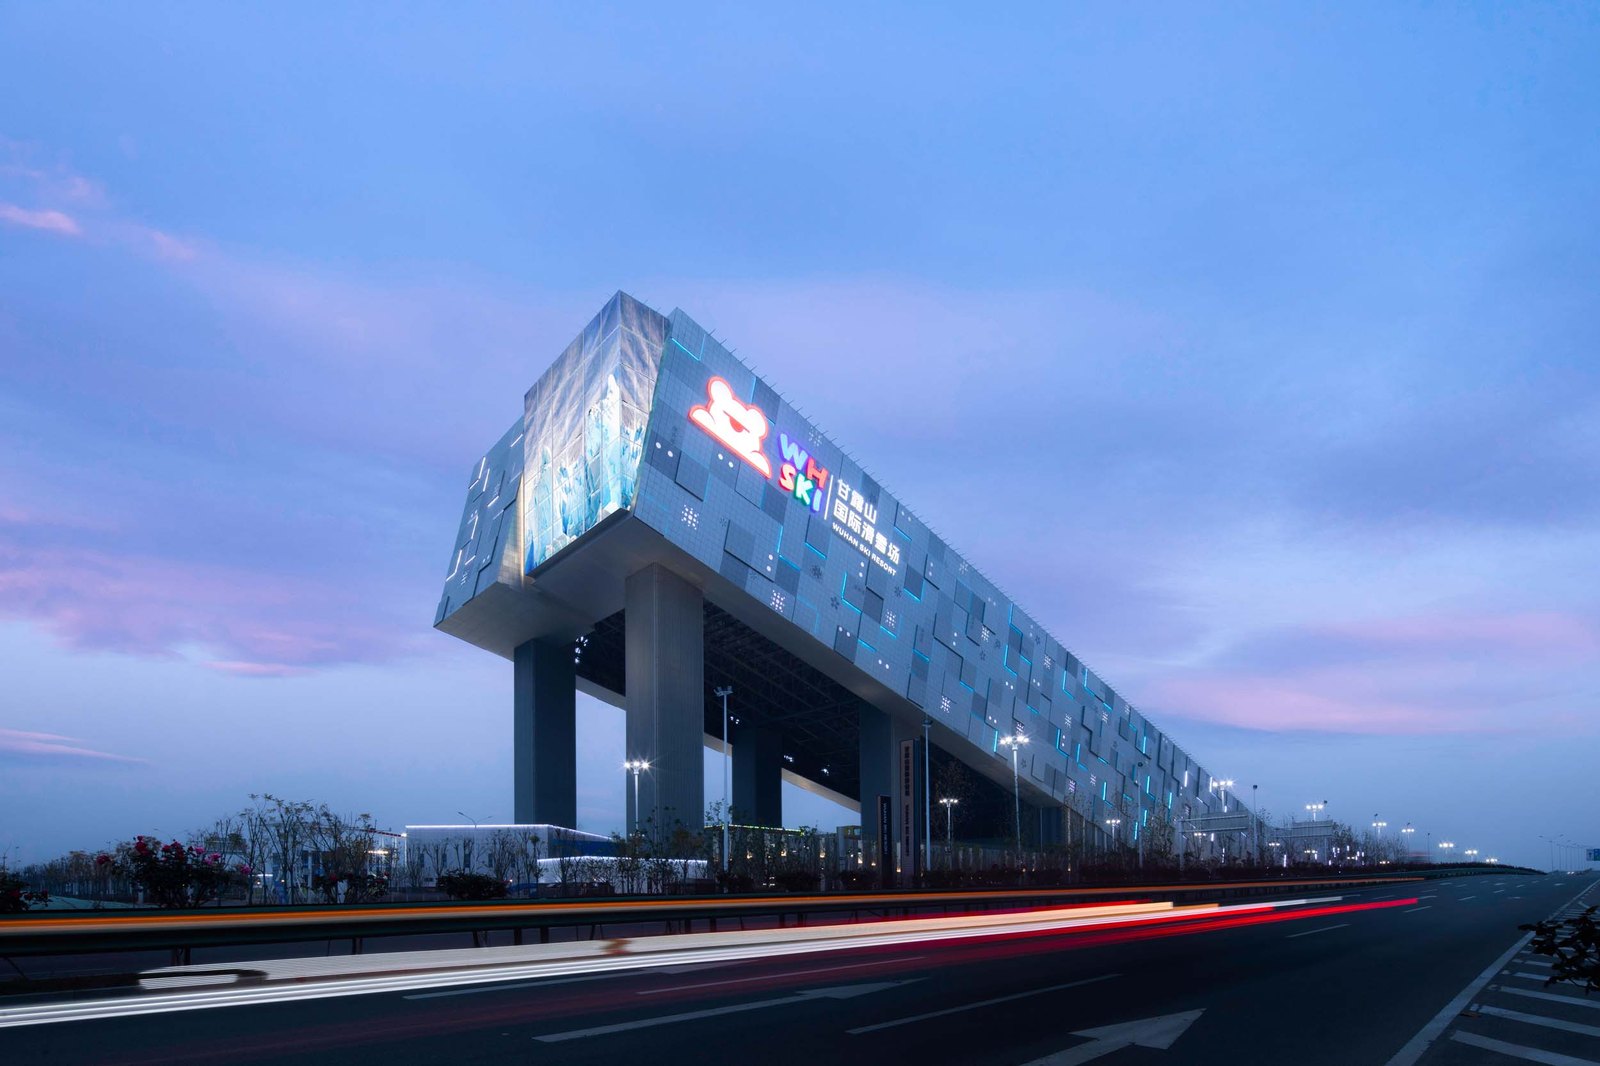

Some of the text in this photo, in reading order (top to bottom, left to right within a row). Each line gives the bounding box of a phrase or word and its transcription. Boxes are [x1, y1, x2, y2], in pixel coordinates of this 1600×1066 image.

[778, 433, 828, 488] WH
[779, 463, 823, 513] SKI
[837, 479, 877, 524] 甘露山
[832, 522, 896, 576] WUHAN SKI RESORT
[833, 499, 900, 565] 国际滑雪场
